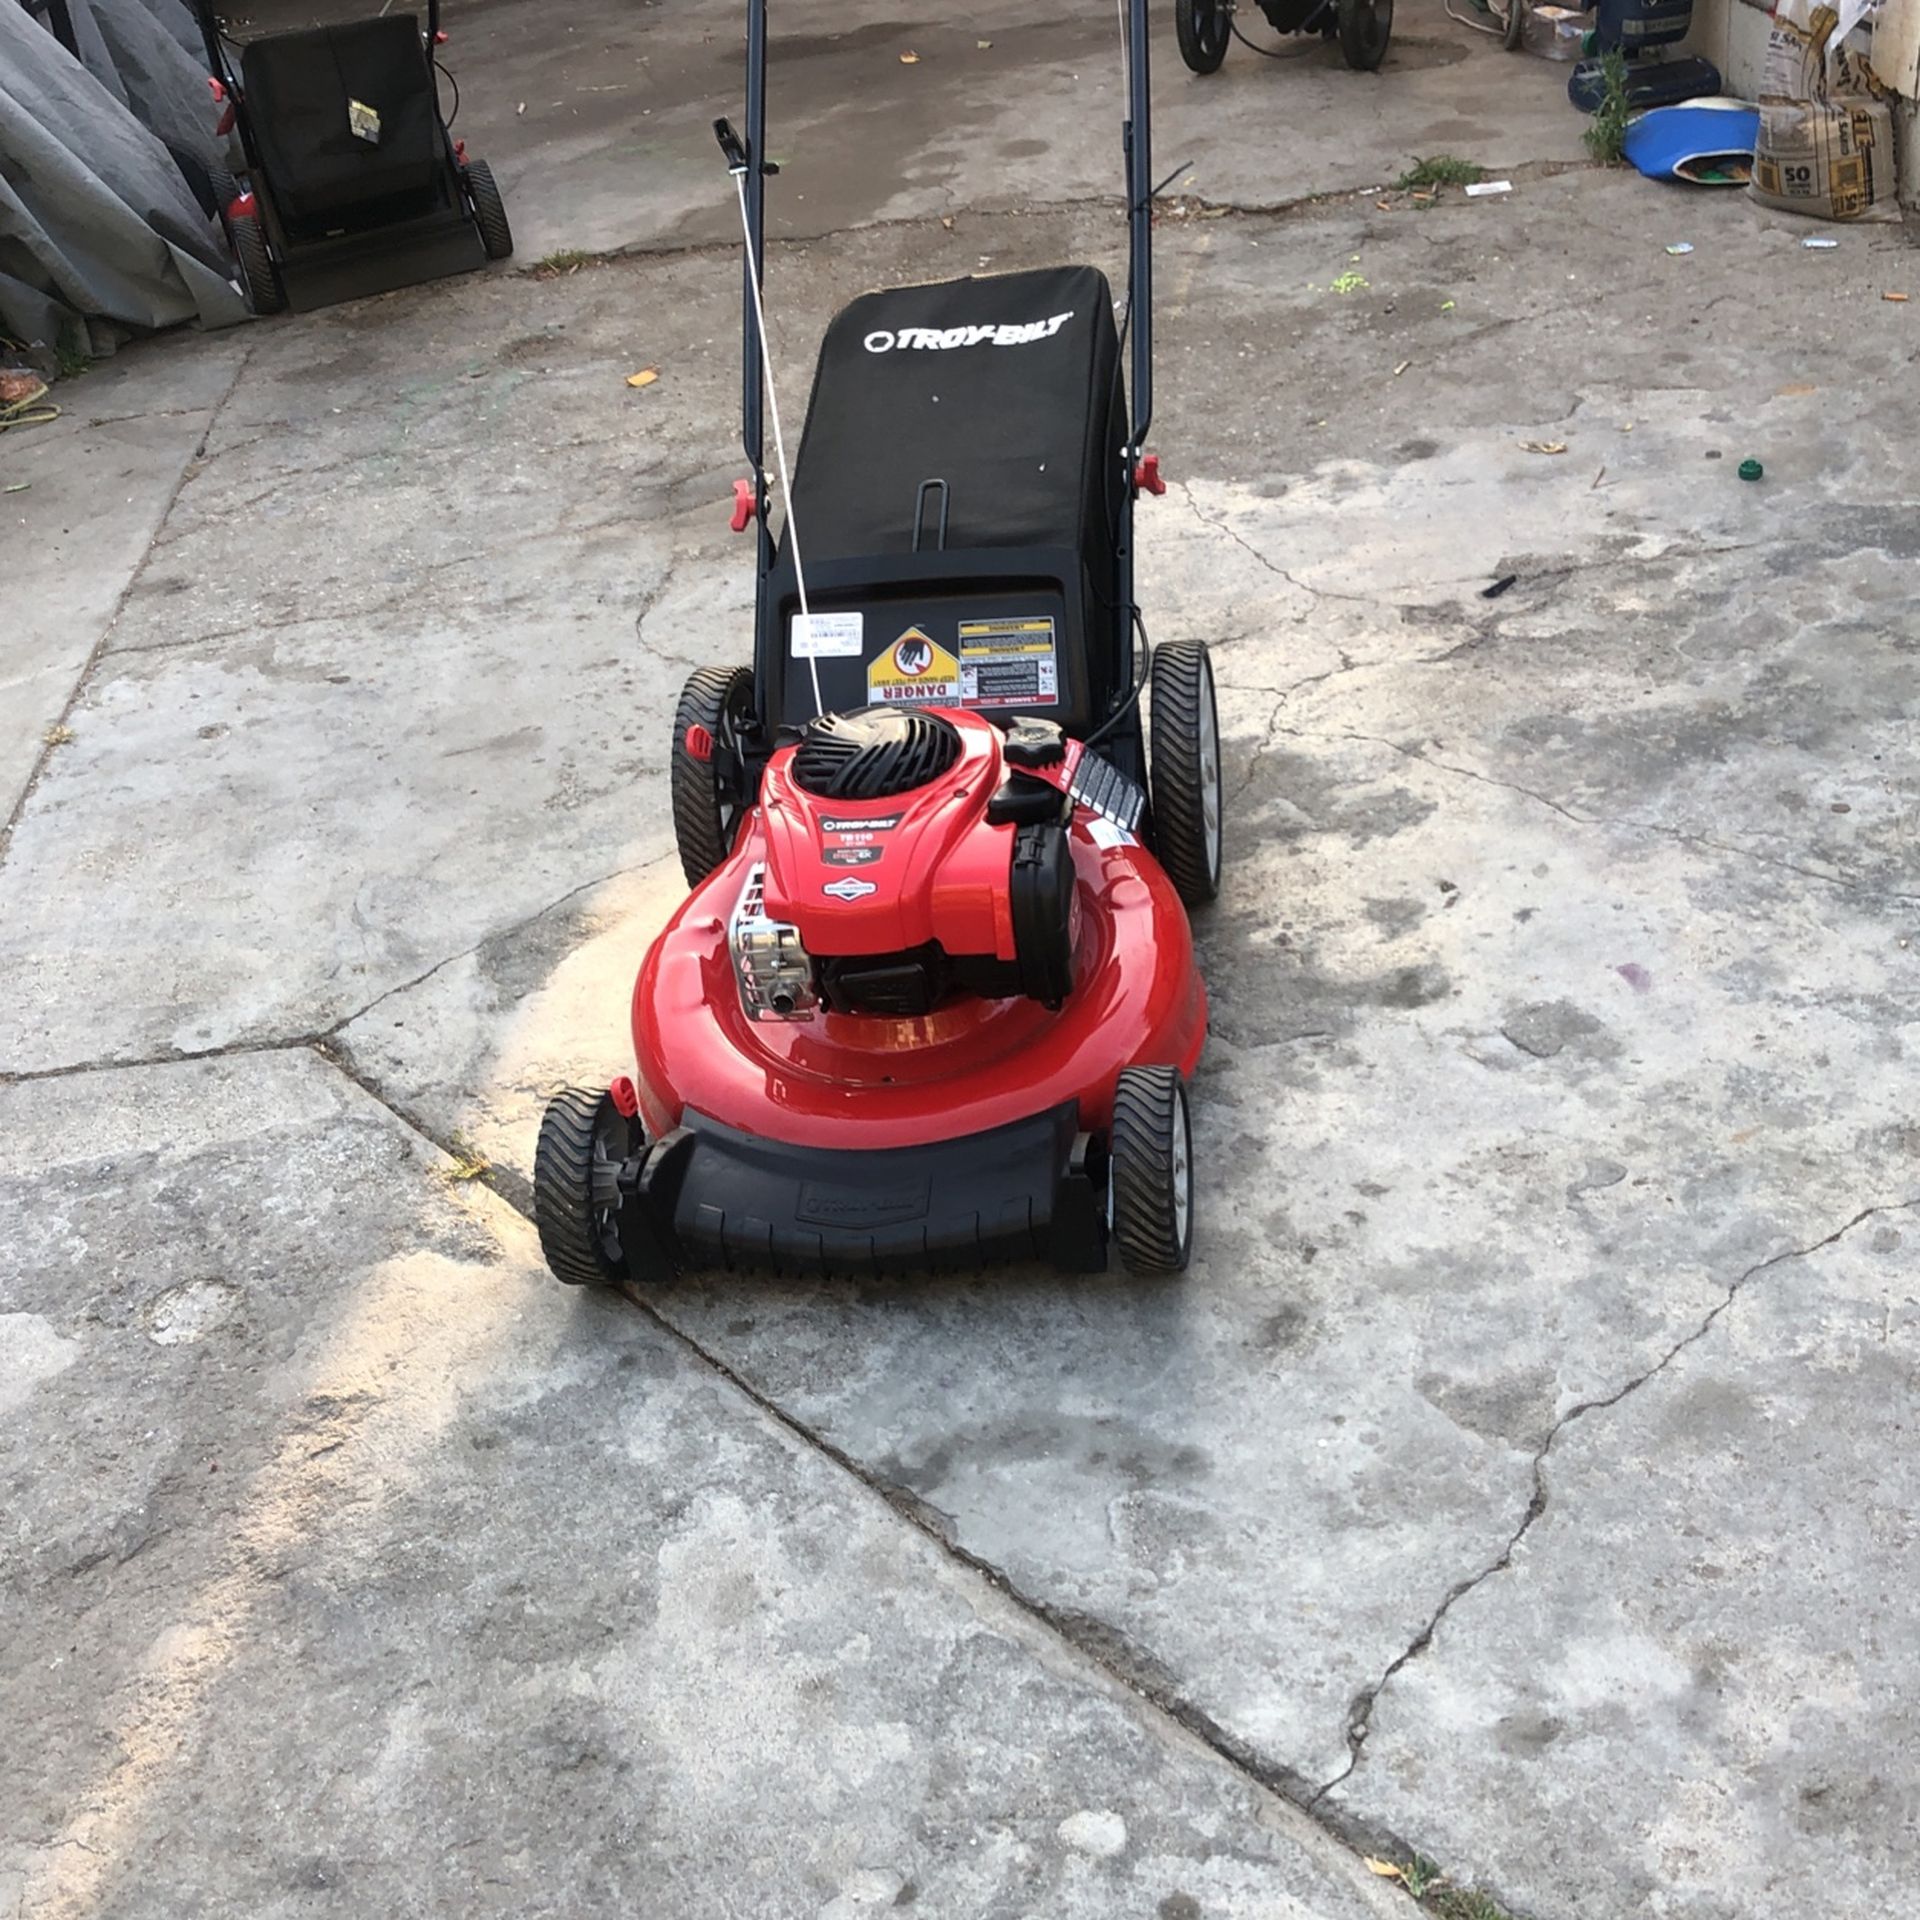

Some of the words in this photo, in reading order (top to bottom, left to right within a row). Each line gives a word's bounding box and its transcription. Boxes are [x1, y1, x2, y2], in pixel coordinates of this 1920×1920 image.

[1784, 166, 1810, 182] 50
[896, 312, 1074, 350] TROY-BILT
[883, 685, 947, 699] DANGER
